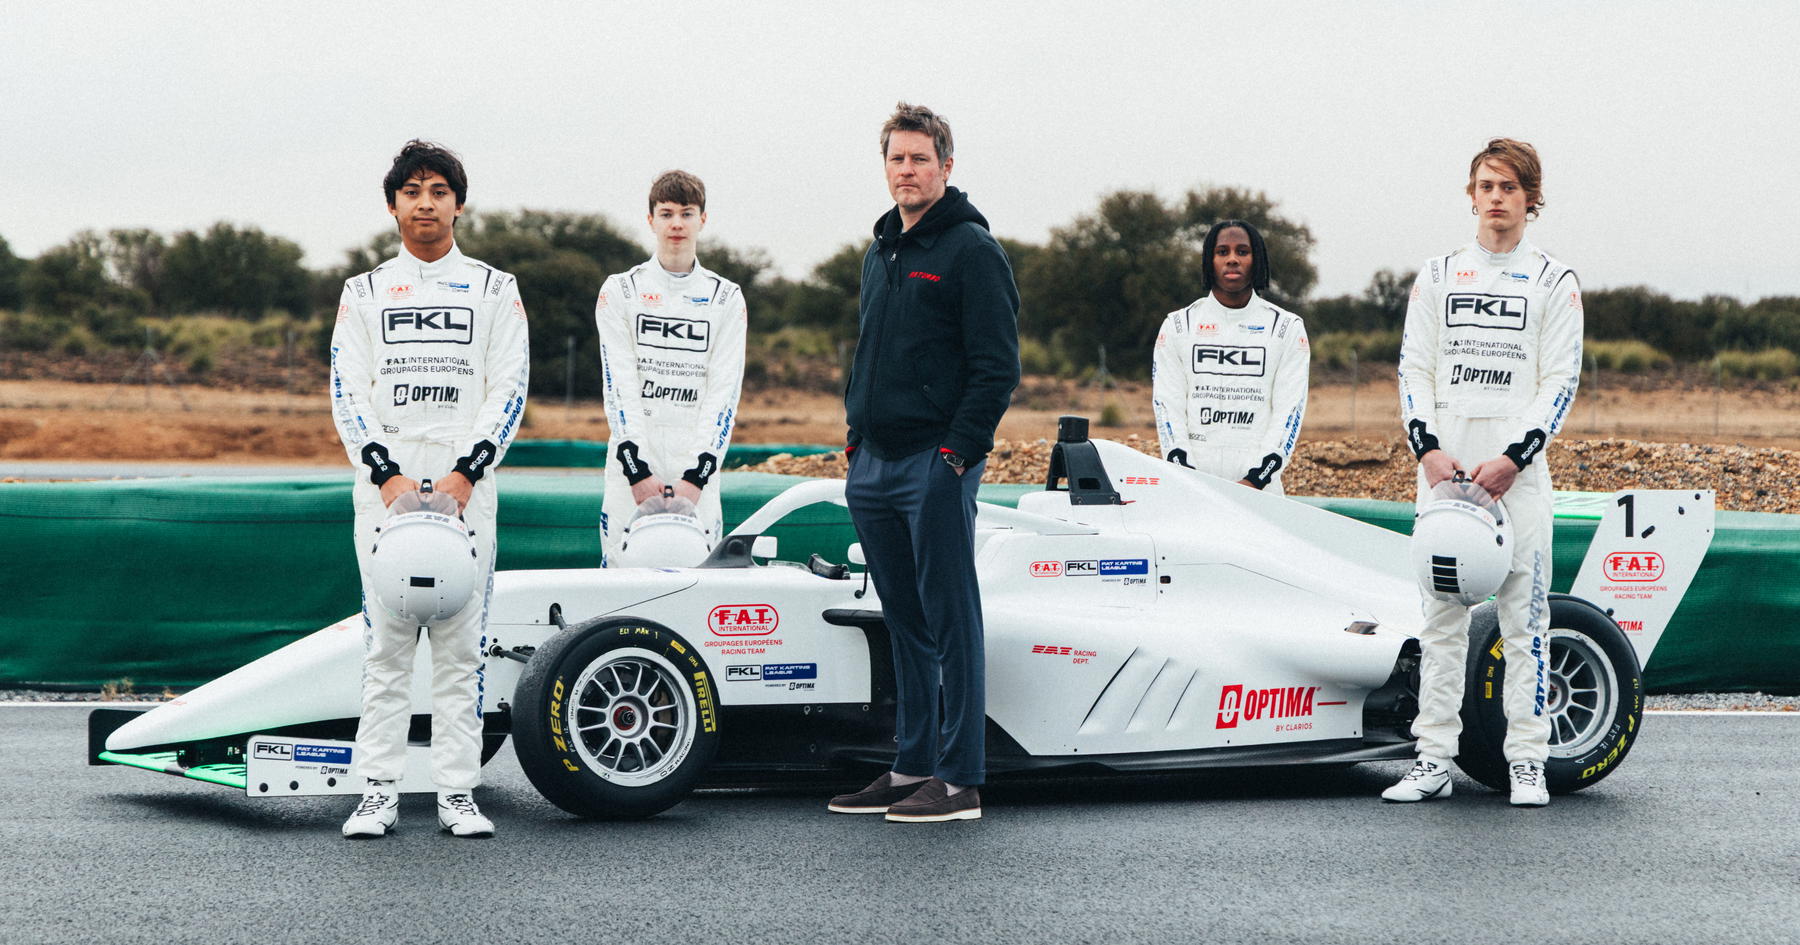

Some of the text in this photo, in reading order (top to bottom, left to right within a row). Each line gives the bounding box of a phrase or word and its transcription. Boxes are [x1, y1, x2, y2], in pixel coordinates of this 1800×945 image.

[1452, 298, 1521, 317] FKL
[388, 312, 468, 331] FKL
[641, 319, 705, 341] FKL
[1198, 349, 1260, 366] FKL
[1482, 350, 1526, 360] EUROPÉENS
[1464, 368, 1512, 386] OPTIMA
[412, 386, 459, 404] OPTIMA
[655, 386, 698, 402] OPTIMA
[1212, 410, 1254, 424] OPTIMA
[1521, 438, 1540, 460] sparco
[1617, 494, 1634, 538] 1
[1618, 621, 1643, 631] PTIMA
[728, 668, 760, 676] FKL
[694, 671, 716, 732] PIRELLI
[1244, 686, 1316, 720] OPTIMA
[550, 680, 568, 752] ZERO
[1286, 723, 1312, 731] CLARIOS
[257, 744, 290, 754] FKL
[1582, 714, 1635, 779] P ZERO
[562, 759, 580, 771] P
